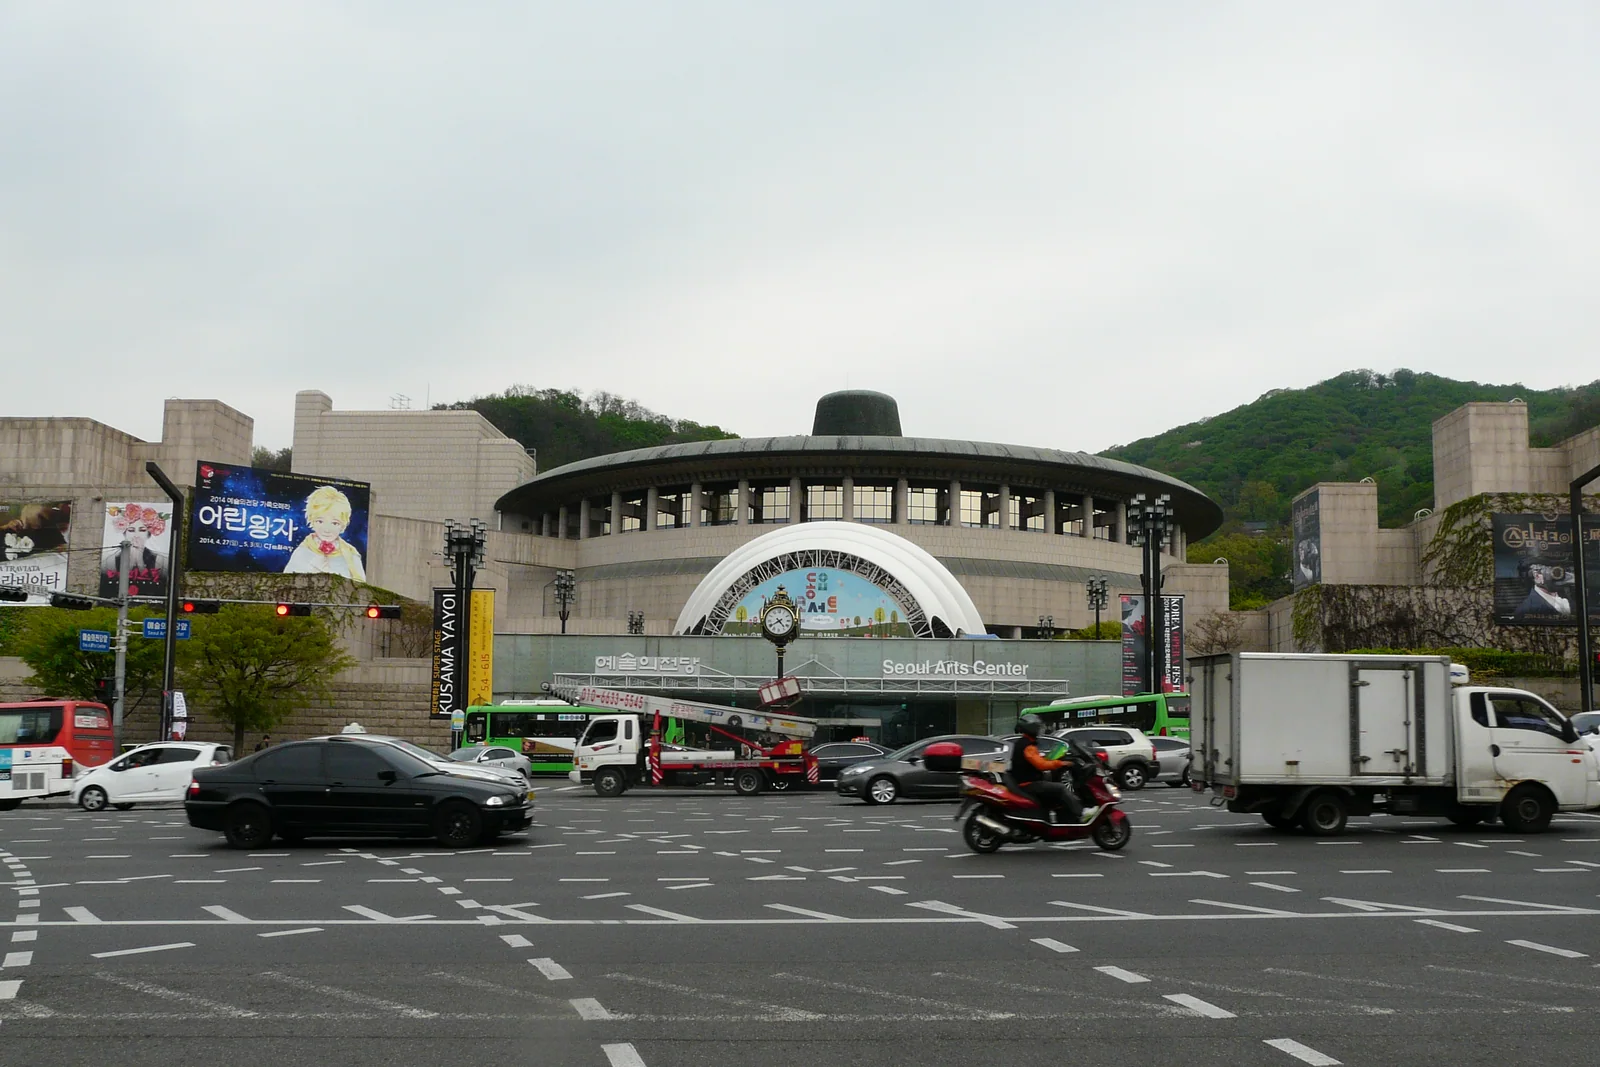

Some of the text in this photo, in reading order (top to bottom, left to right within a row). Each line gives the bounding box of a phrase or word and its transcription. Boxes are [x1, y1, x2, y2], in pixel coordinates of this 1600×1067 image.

[199, 505, 298, 542] 어린왕자
[6, 565, 40, 573] TRAVIATA
[1171, 598, 1180, 630] KOREA
[440, 594, 456, 714] KUSAMA YAYOI
[596, 652, 700, 674] 예술의전당
[1171, 632, 1180, 664] OPERA
[883, 660, 1029, 675] Seoul Arts Center
